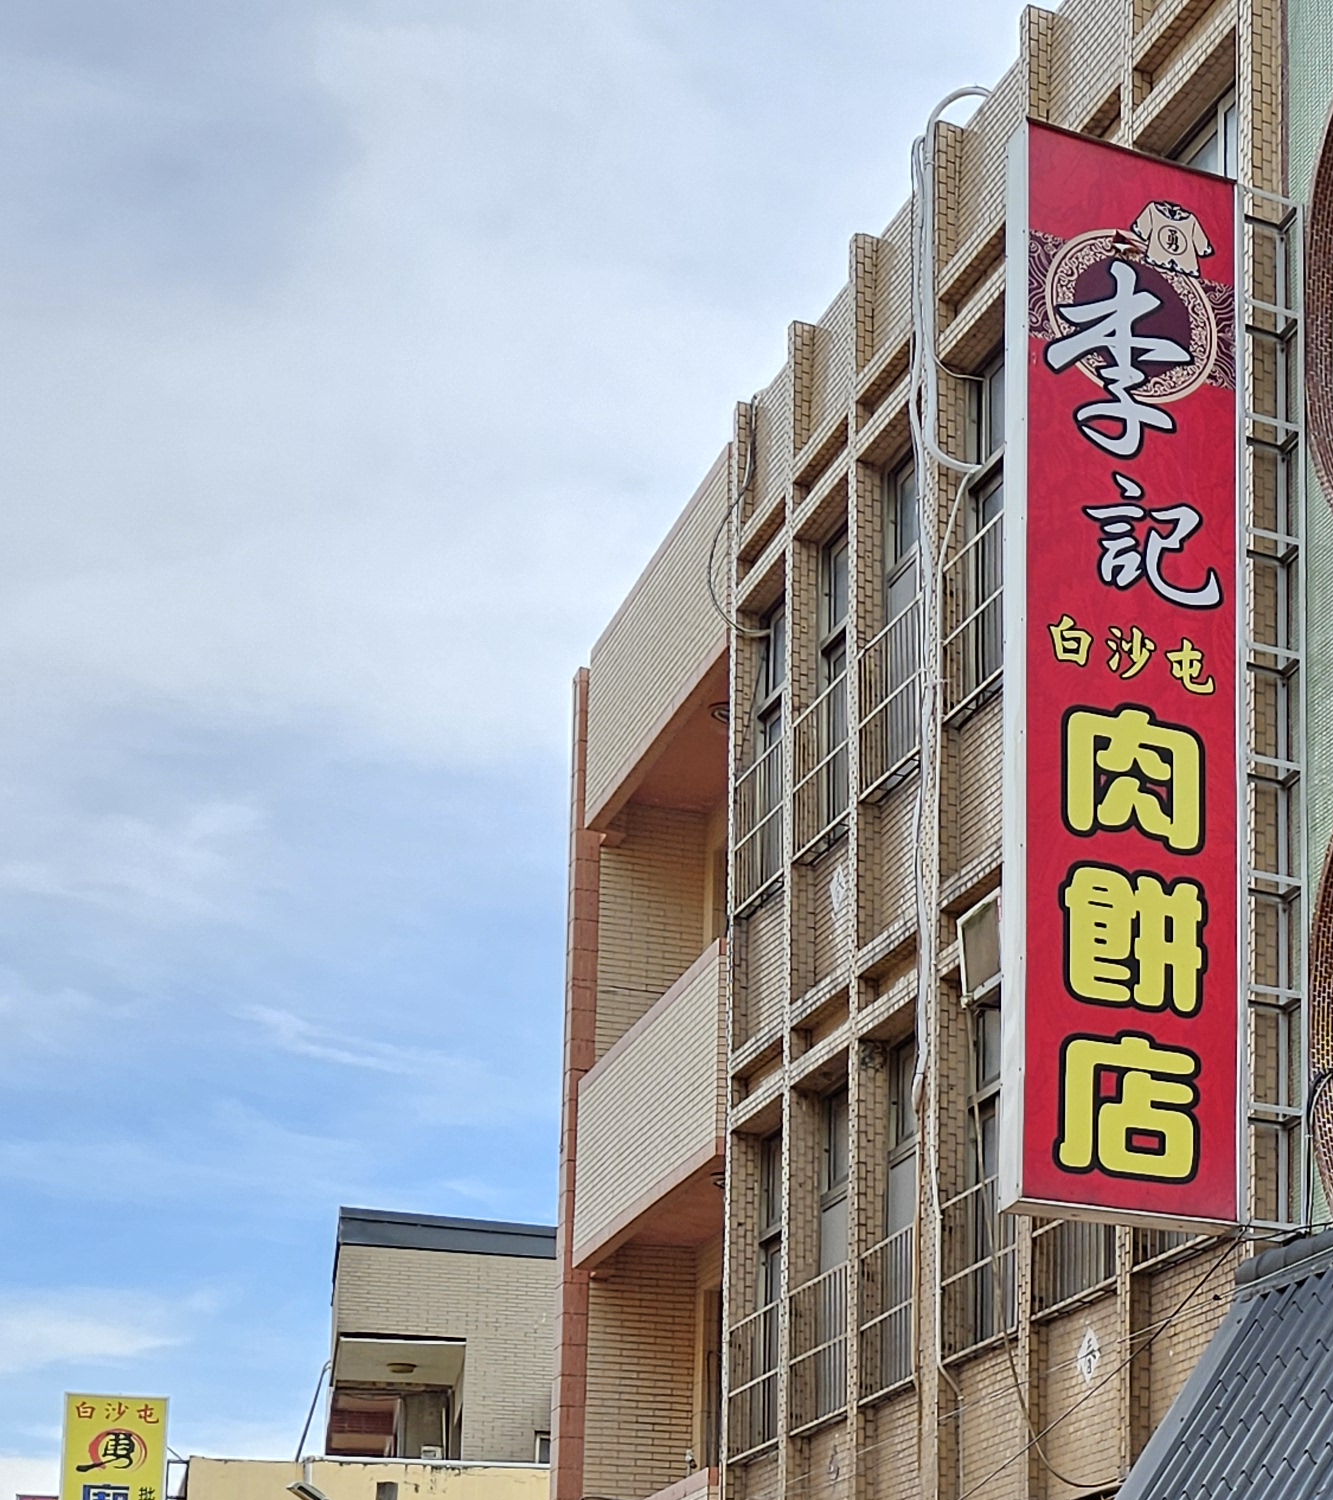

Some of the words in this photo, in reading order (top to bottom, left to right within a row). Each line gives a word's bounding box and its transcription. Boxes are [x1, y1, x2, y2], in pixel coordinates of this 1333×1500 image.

[1044, 258, 1222, 607] 李記
[1048, 615, 1216, 694] 白沙屯
[1054, 703, 1207, 1183] 肉餅店
[76, 1401, 159, 1424] 白沙屯
